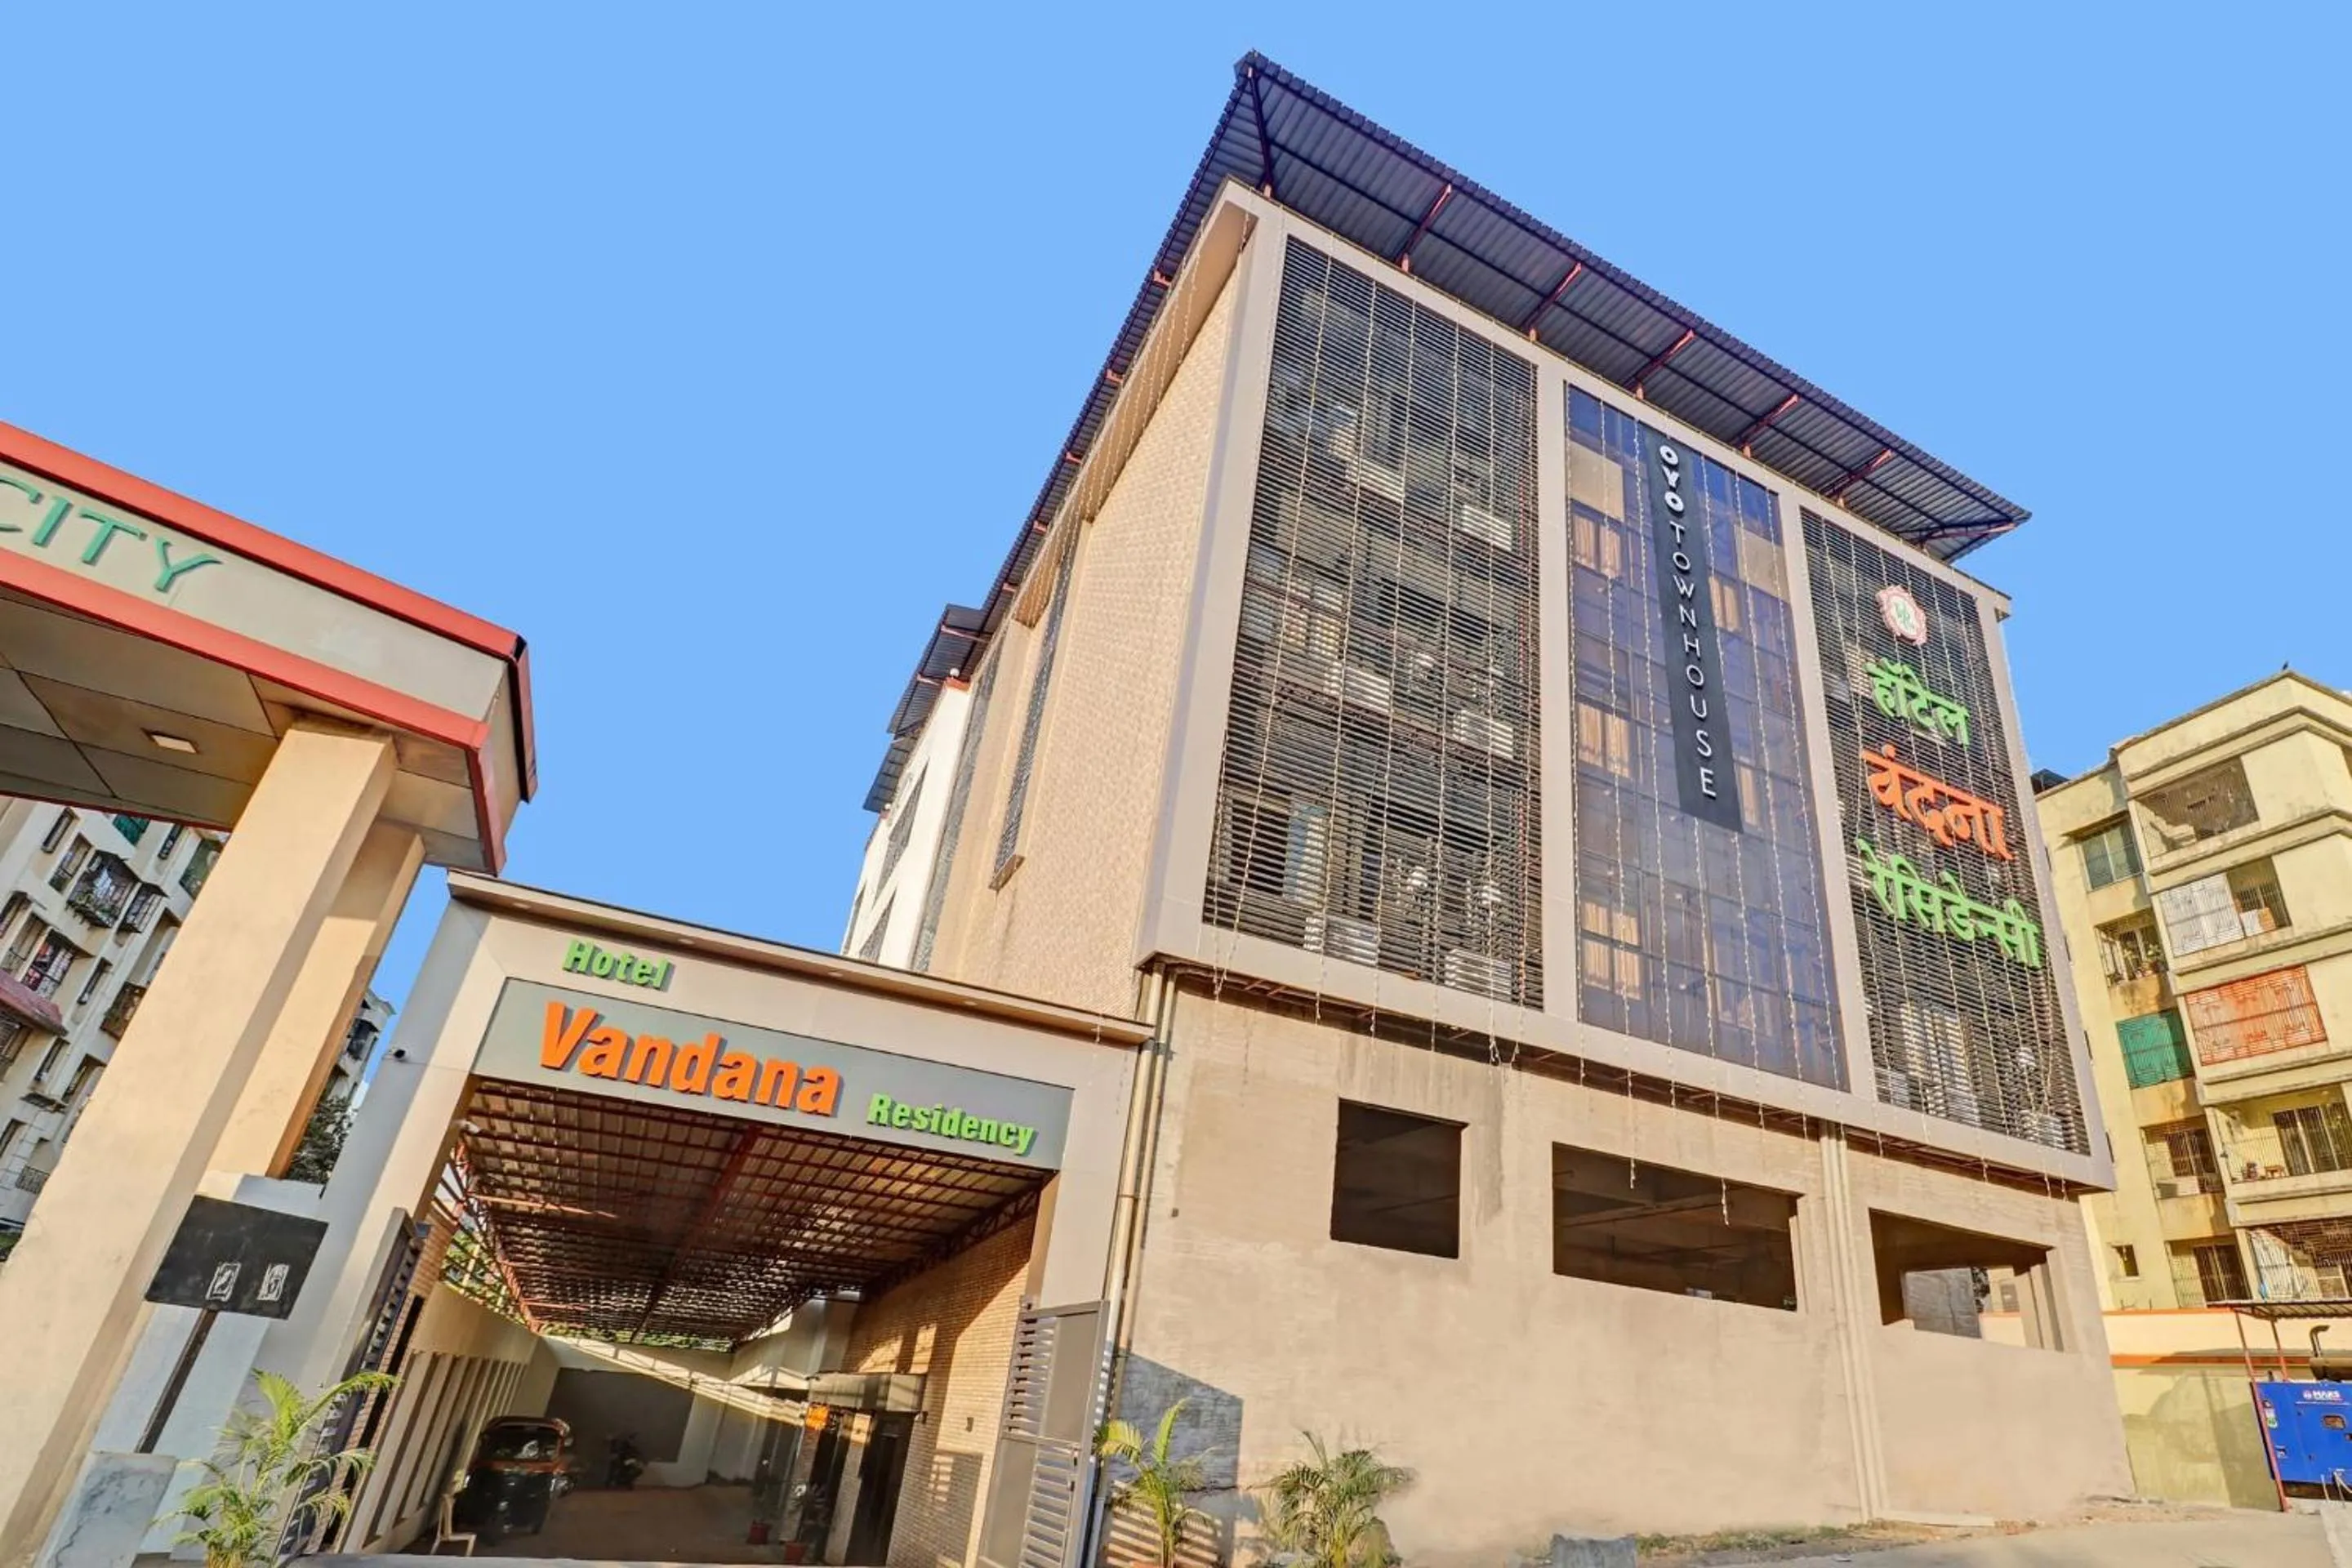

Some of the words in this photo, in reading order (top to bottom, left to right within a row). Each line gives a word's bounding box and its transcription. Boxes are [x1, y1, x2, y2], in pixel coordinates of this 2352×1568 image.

[1659, 445, 1685, 513] OYO
[1669, 520, 1716, 798] TOWNHOUSE
[1860, 744, 2013, 860] वंदना
[563, 940, 672, 989] Hotel
[540, 1002, 842, 1116] Vandana
[867, 1093, 1035, 1156] Residency
